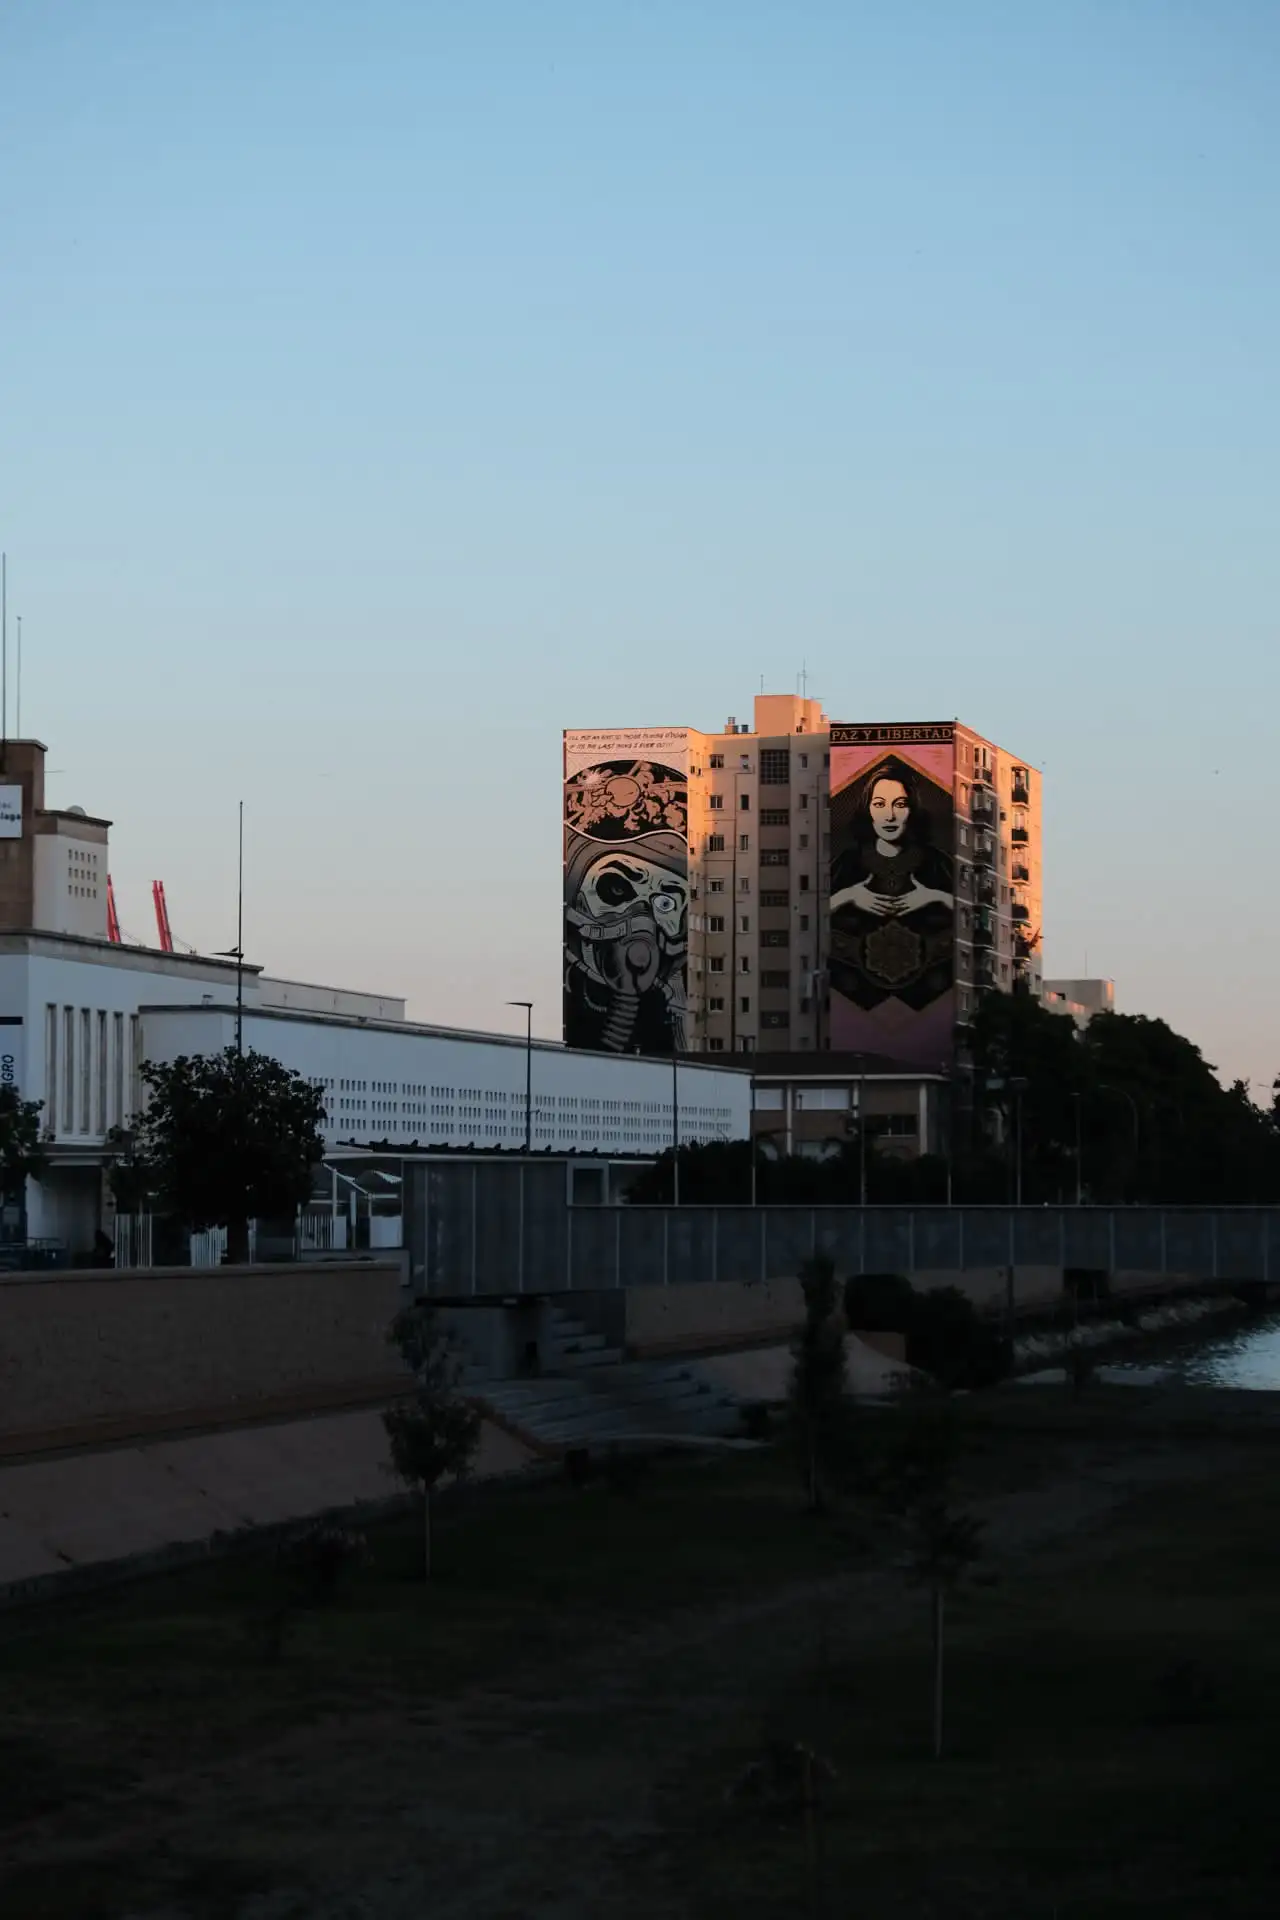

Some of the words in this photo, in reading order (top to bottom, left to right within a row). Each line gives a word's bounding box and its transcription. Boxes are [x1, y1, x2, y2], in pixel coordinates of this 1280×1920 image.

[832, 730, 858, 741] PAZ
[863, 730, 872, 740] Y
[877, 728, 952, 740] LIBERTAD
[598, 742, 615, 750] LAST
